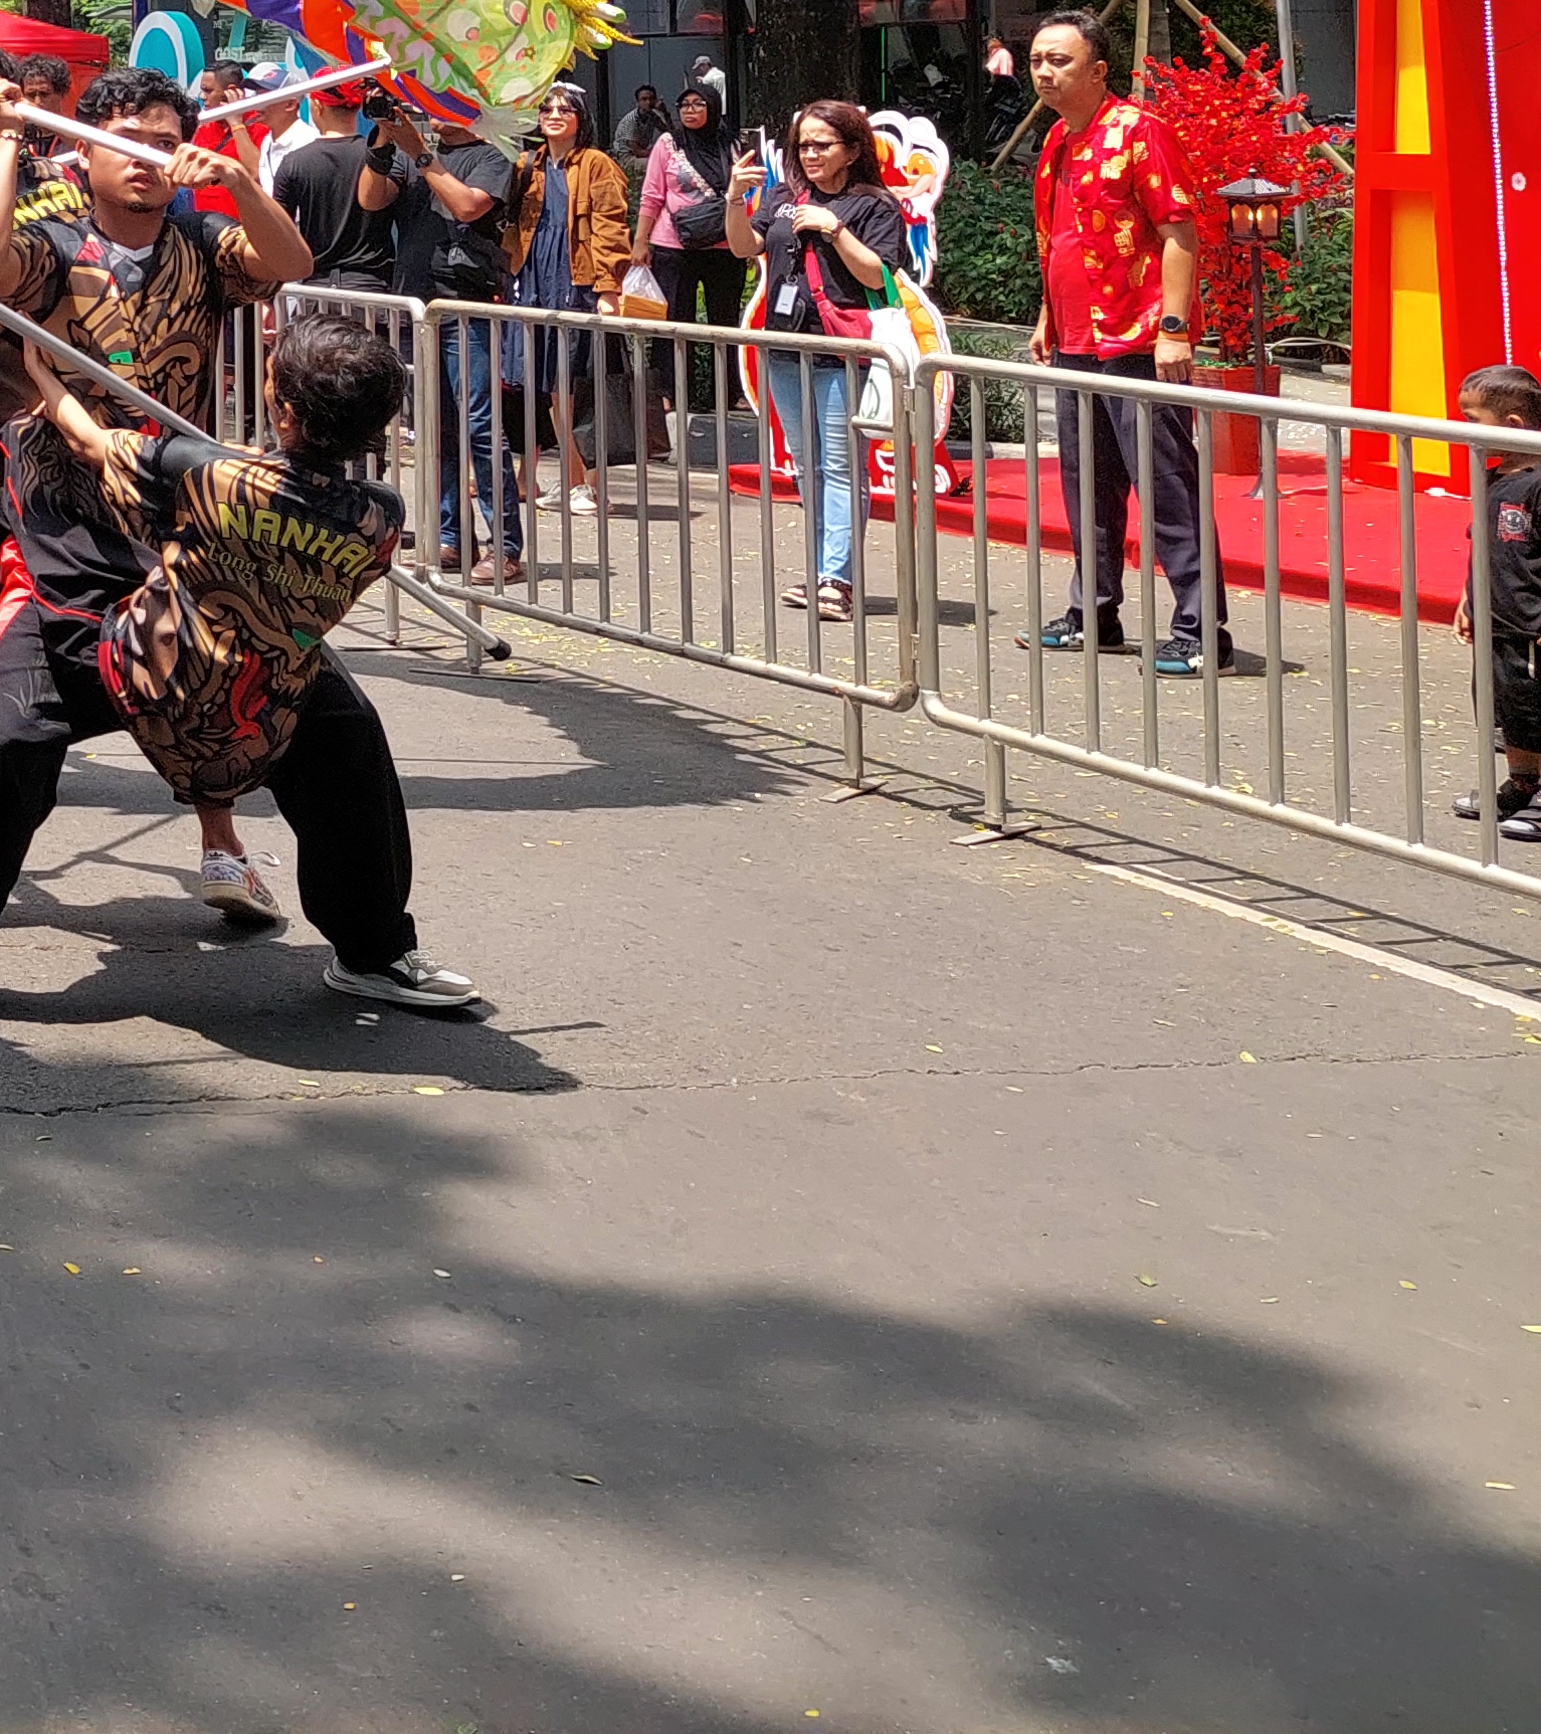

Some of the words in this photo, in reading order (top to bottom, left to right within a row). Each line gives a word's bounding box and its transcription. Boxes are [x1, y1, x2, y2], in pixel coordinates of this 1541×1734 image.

[208, 542, 257, 580] Long
[263, 564, 297, 587] Shi
[217, 502, 376, 579] NANHAI
